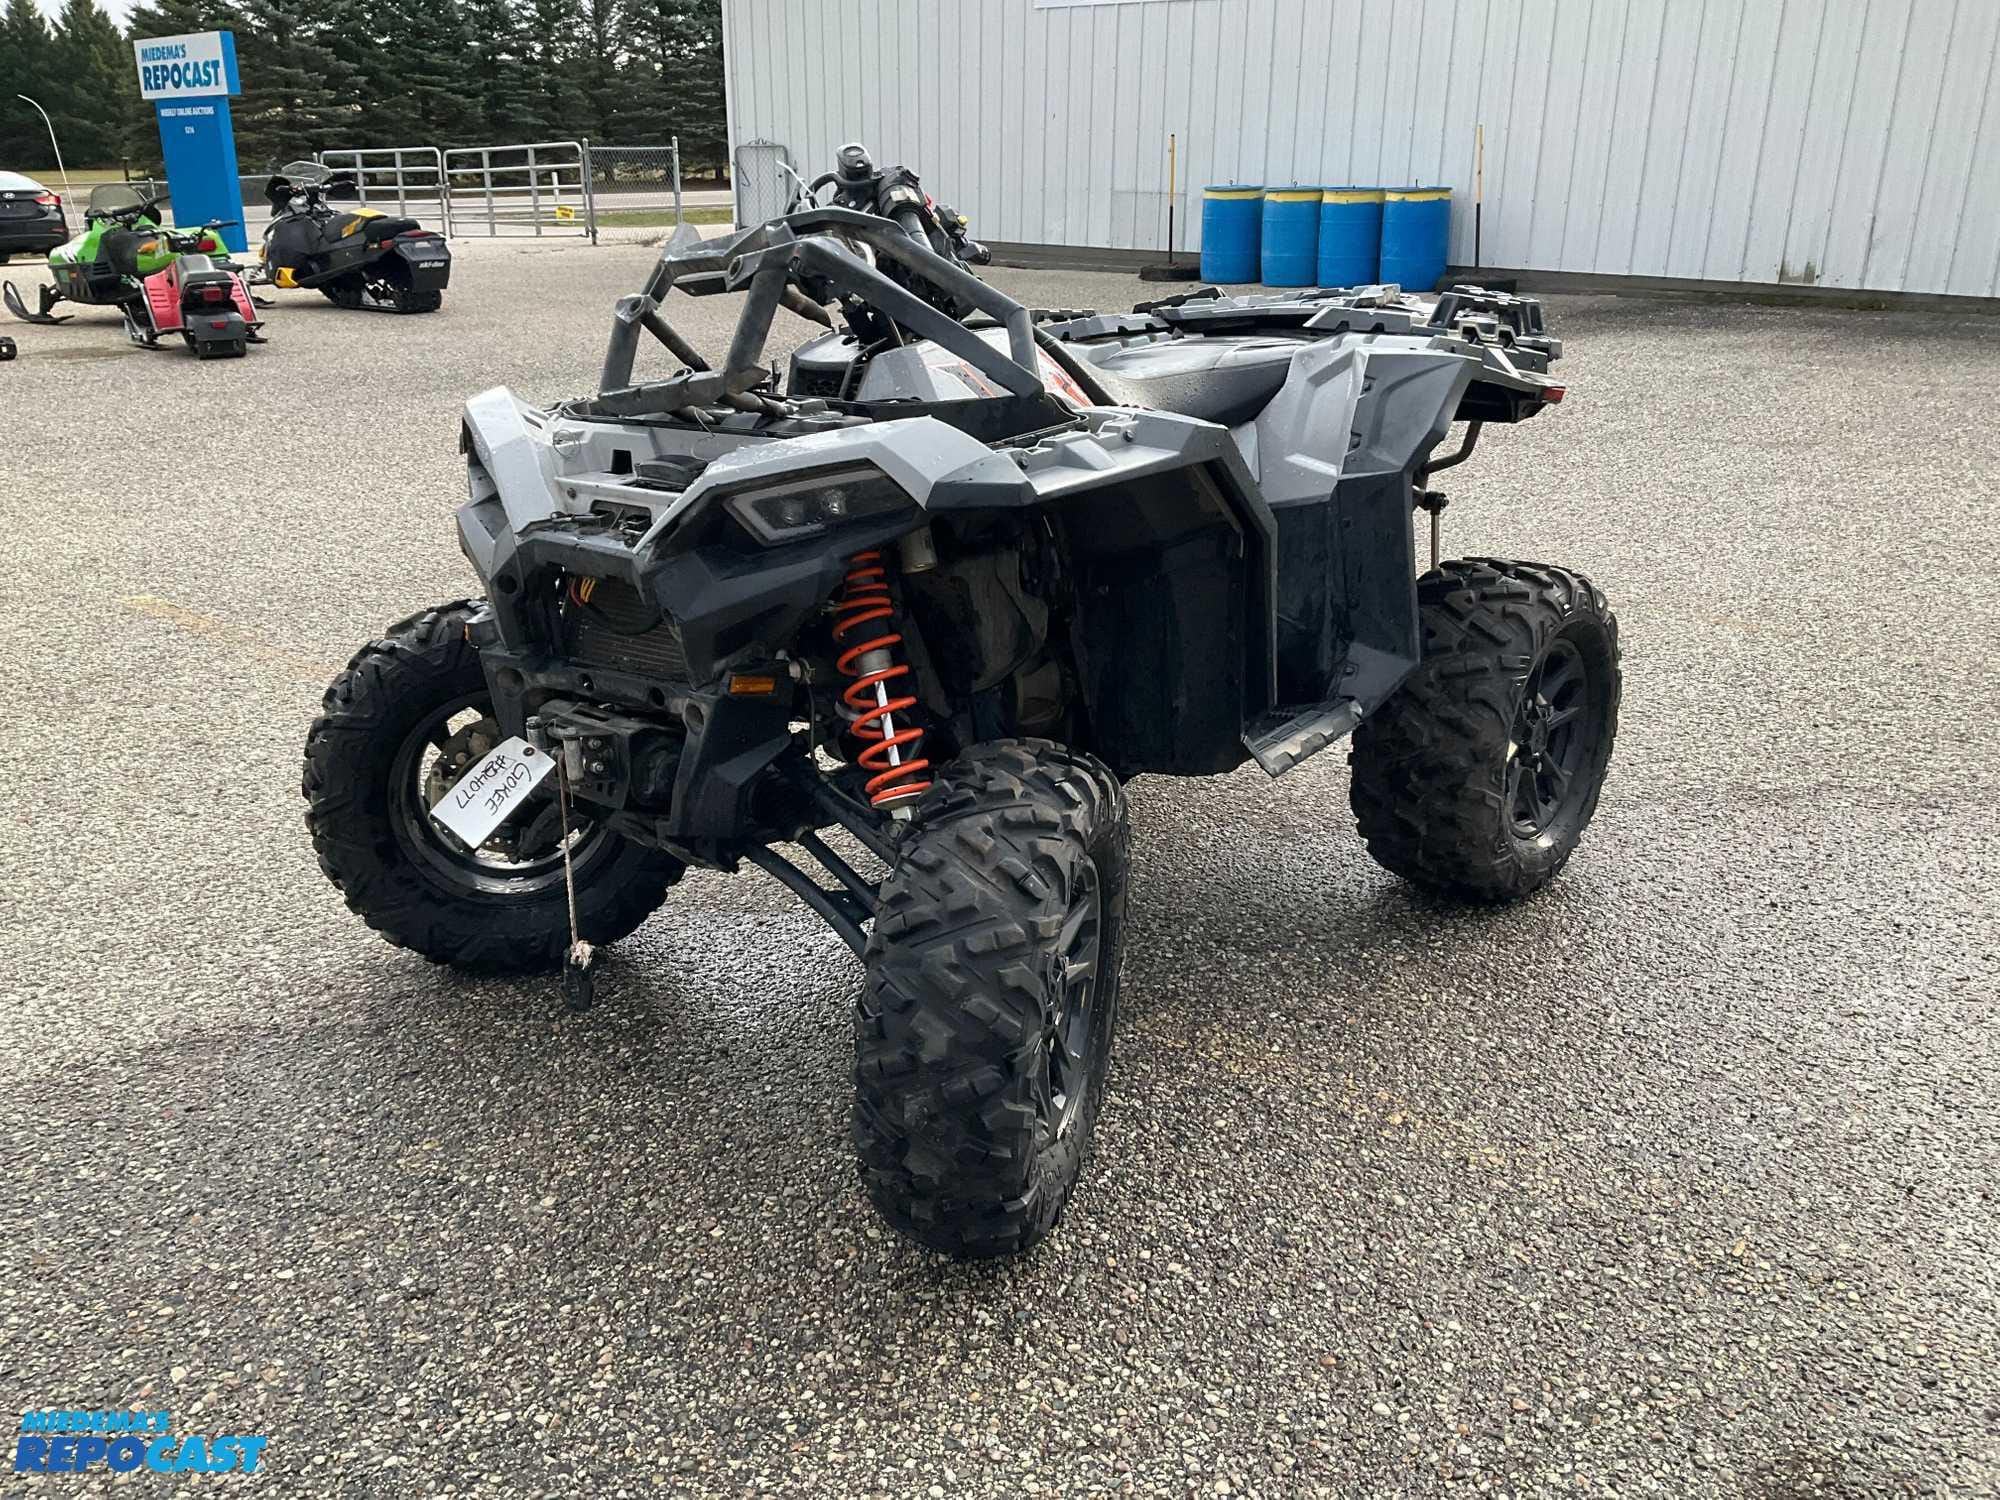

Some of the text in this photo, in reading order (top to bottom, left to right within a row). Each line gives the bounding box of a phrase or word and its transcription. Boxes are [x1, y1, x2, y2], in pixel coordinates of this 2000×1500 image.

[141, 44, 187, 62] MIEDEMA'S
[142, 60, 220, 91] REPOCAST
[484, 762, 532, 816] GOKEE
